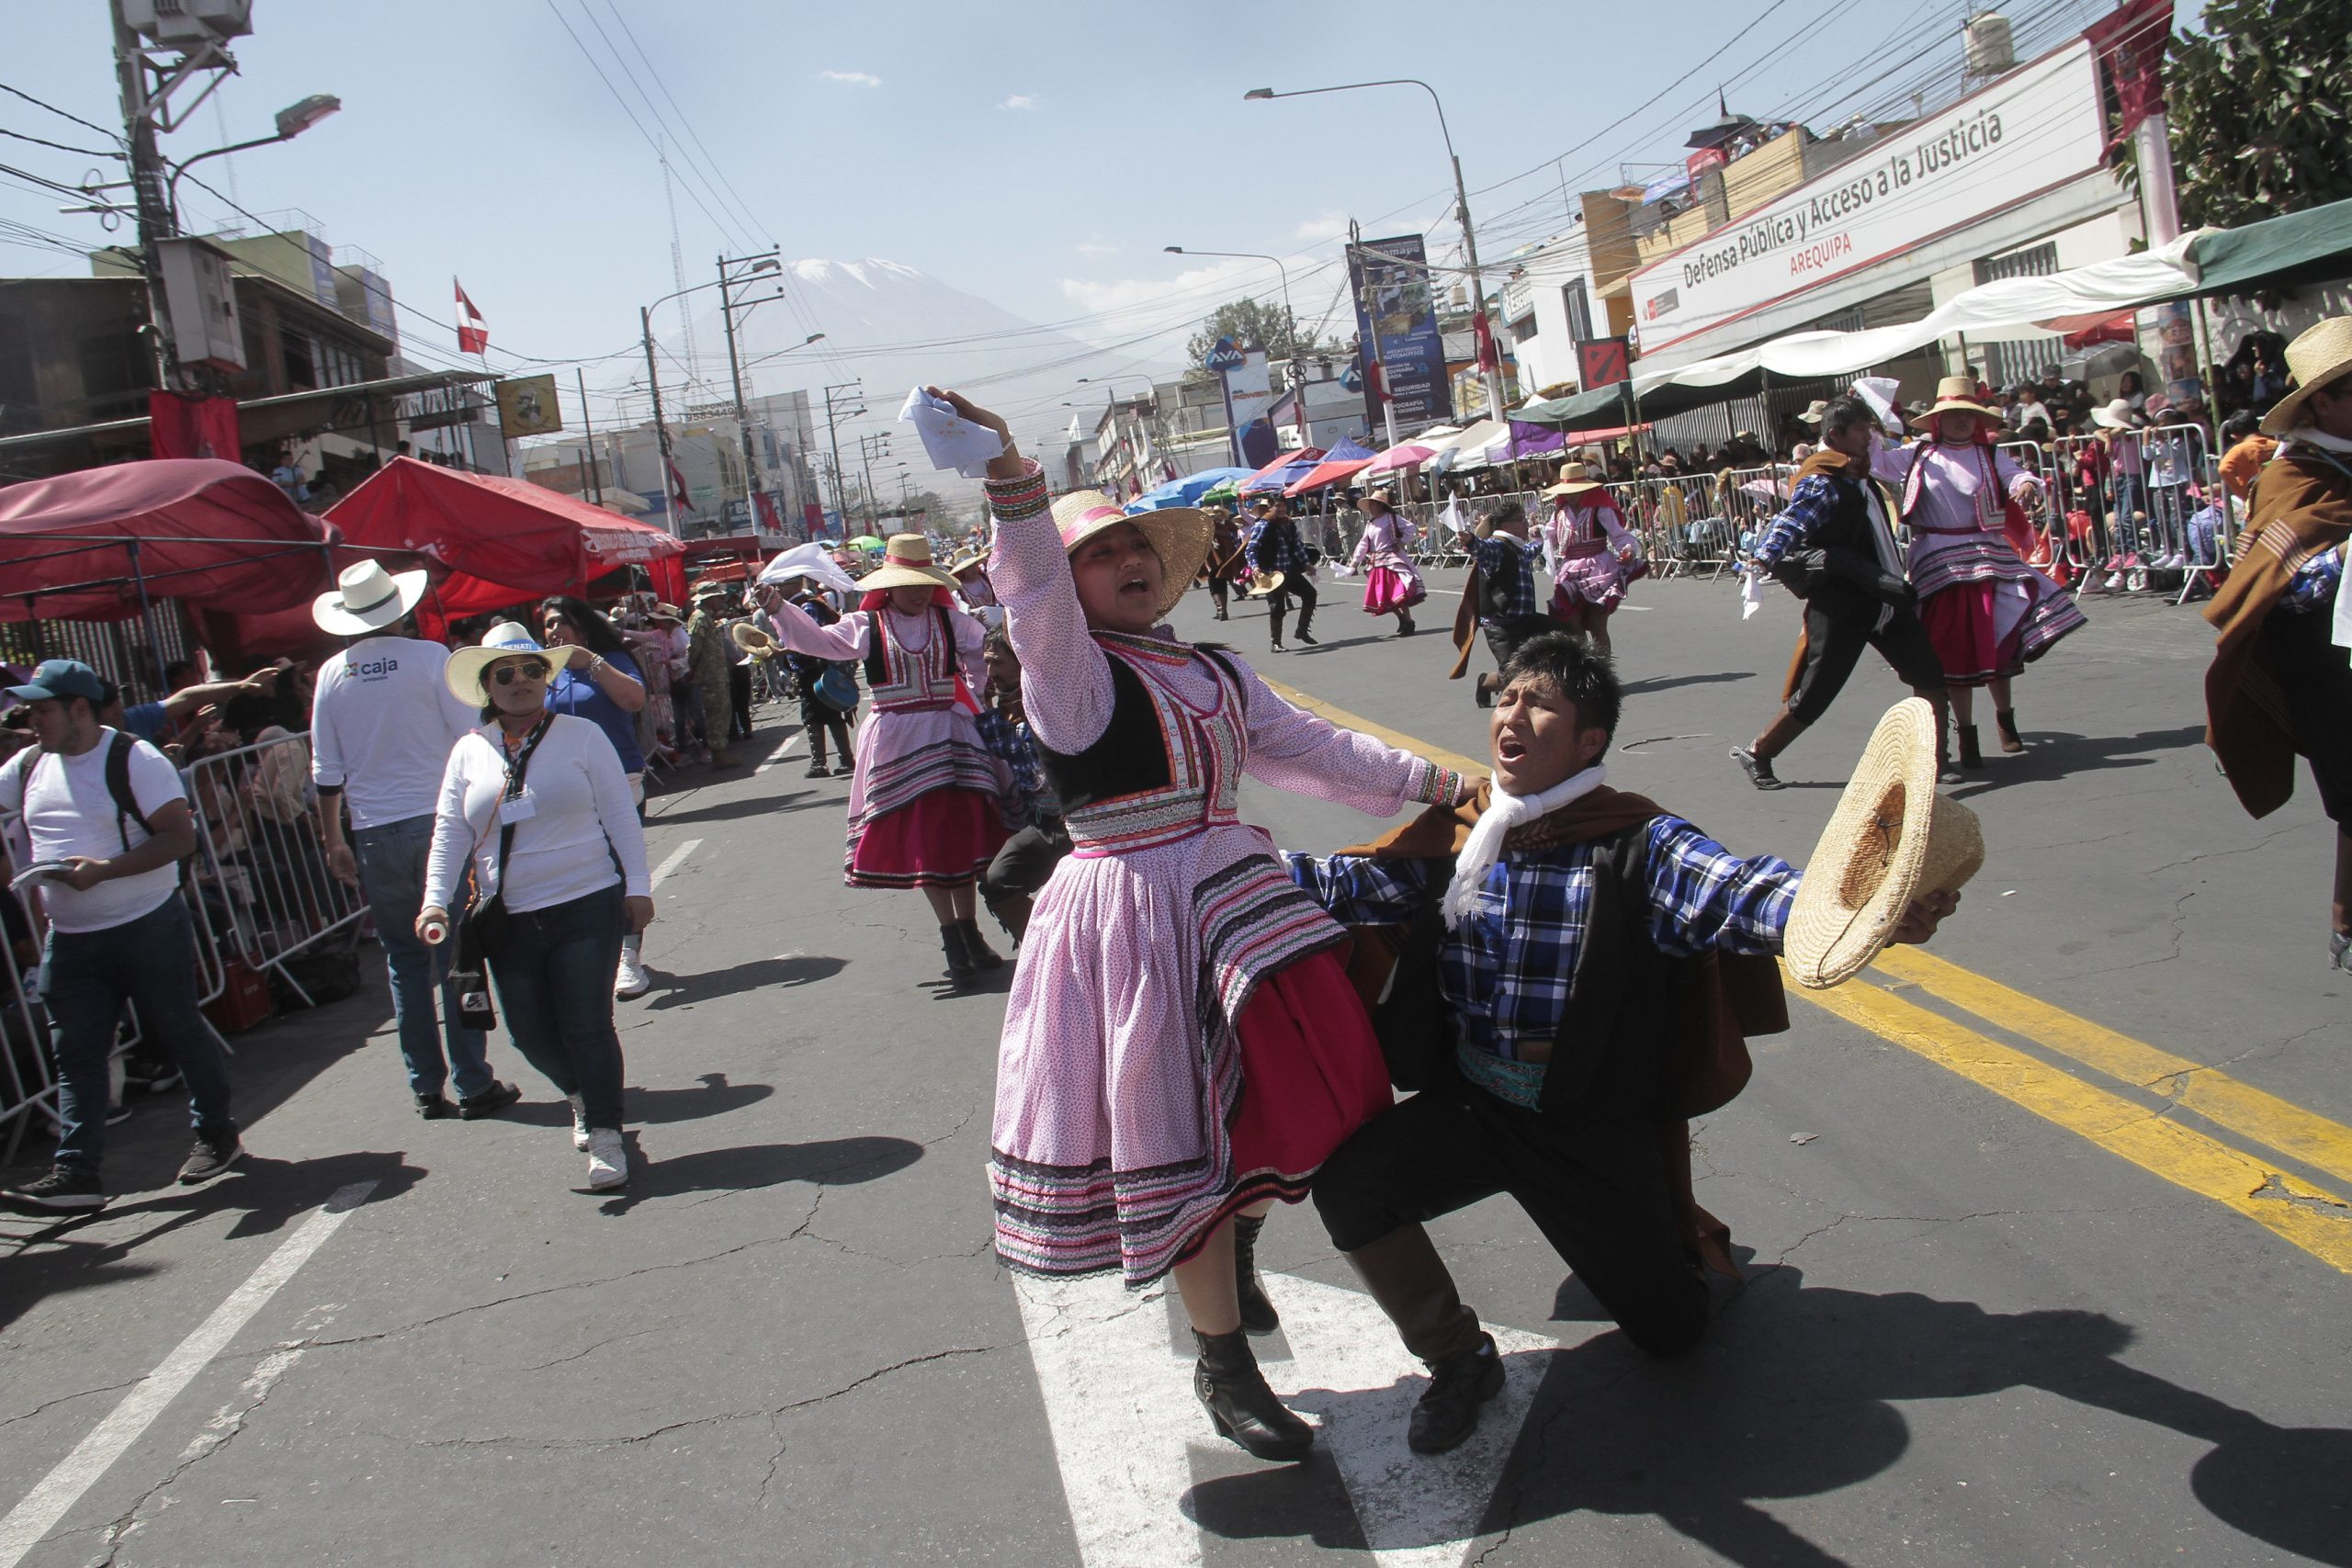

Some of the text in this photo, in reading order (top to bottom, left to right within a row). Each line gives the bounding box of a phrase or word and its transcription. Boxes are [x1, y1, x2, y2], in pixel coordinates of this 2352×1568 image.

[1683, 109, 2002, 288] Defensa Pública y Acceso a la Justicia
[1791, 232, 1852, 276] AREQUIPA
[1210, 350, 1245, 363] AVA
[1394, 382, 1430, 393] SEGURIDAD
[690, 400, 735, 412] DISPONIBL
[361, 657, 398, 674] caja
